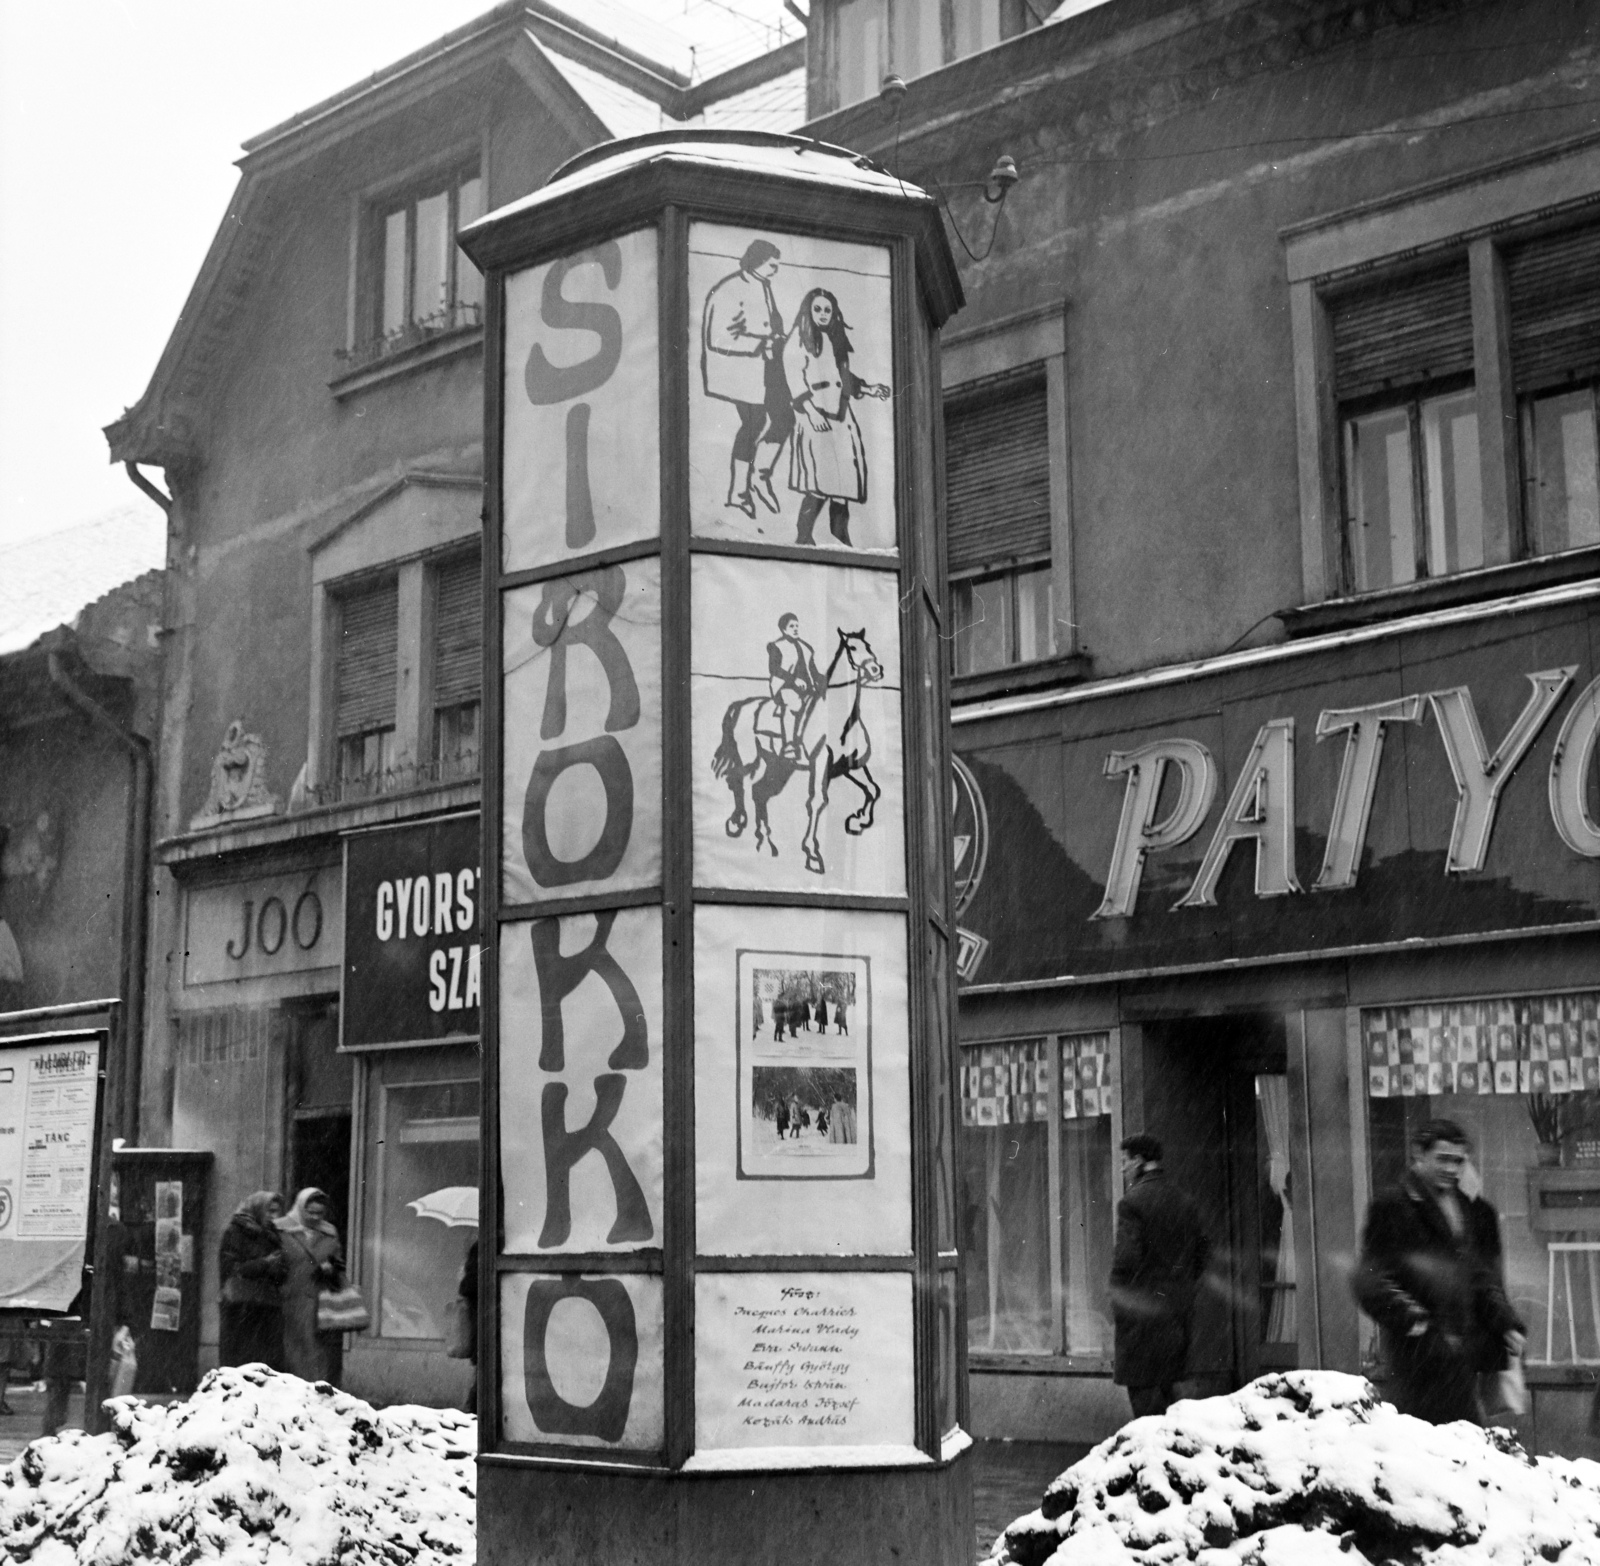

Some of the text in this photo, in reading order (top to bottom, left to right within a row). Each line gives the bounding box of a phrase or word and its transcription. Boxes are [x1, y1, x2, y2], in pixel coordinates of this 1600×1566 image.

[522, 238, 655, 1444] SIROKKO
[376, 866, 481, 941] GYORS
[226, 868, 323, 960] JOÓ
[752, 1323, 860, 1340] Marina Vlady
[800, 1360, 851, 1375] György
[737, 1397, 808, 1408] Madaras
[742, 1414, 847, 1428] Kozák András
